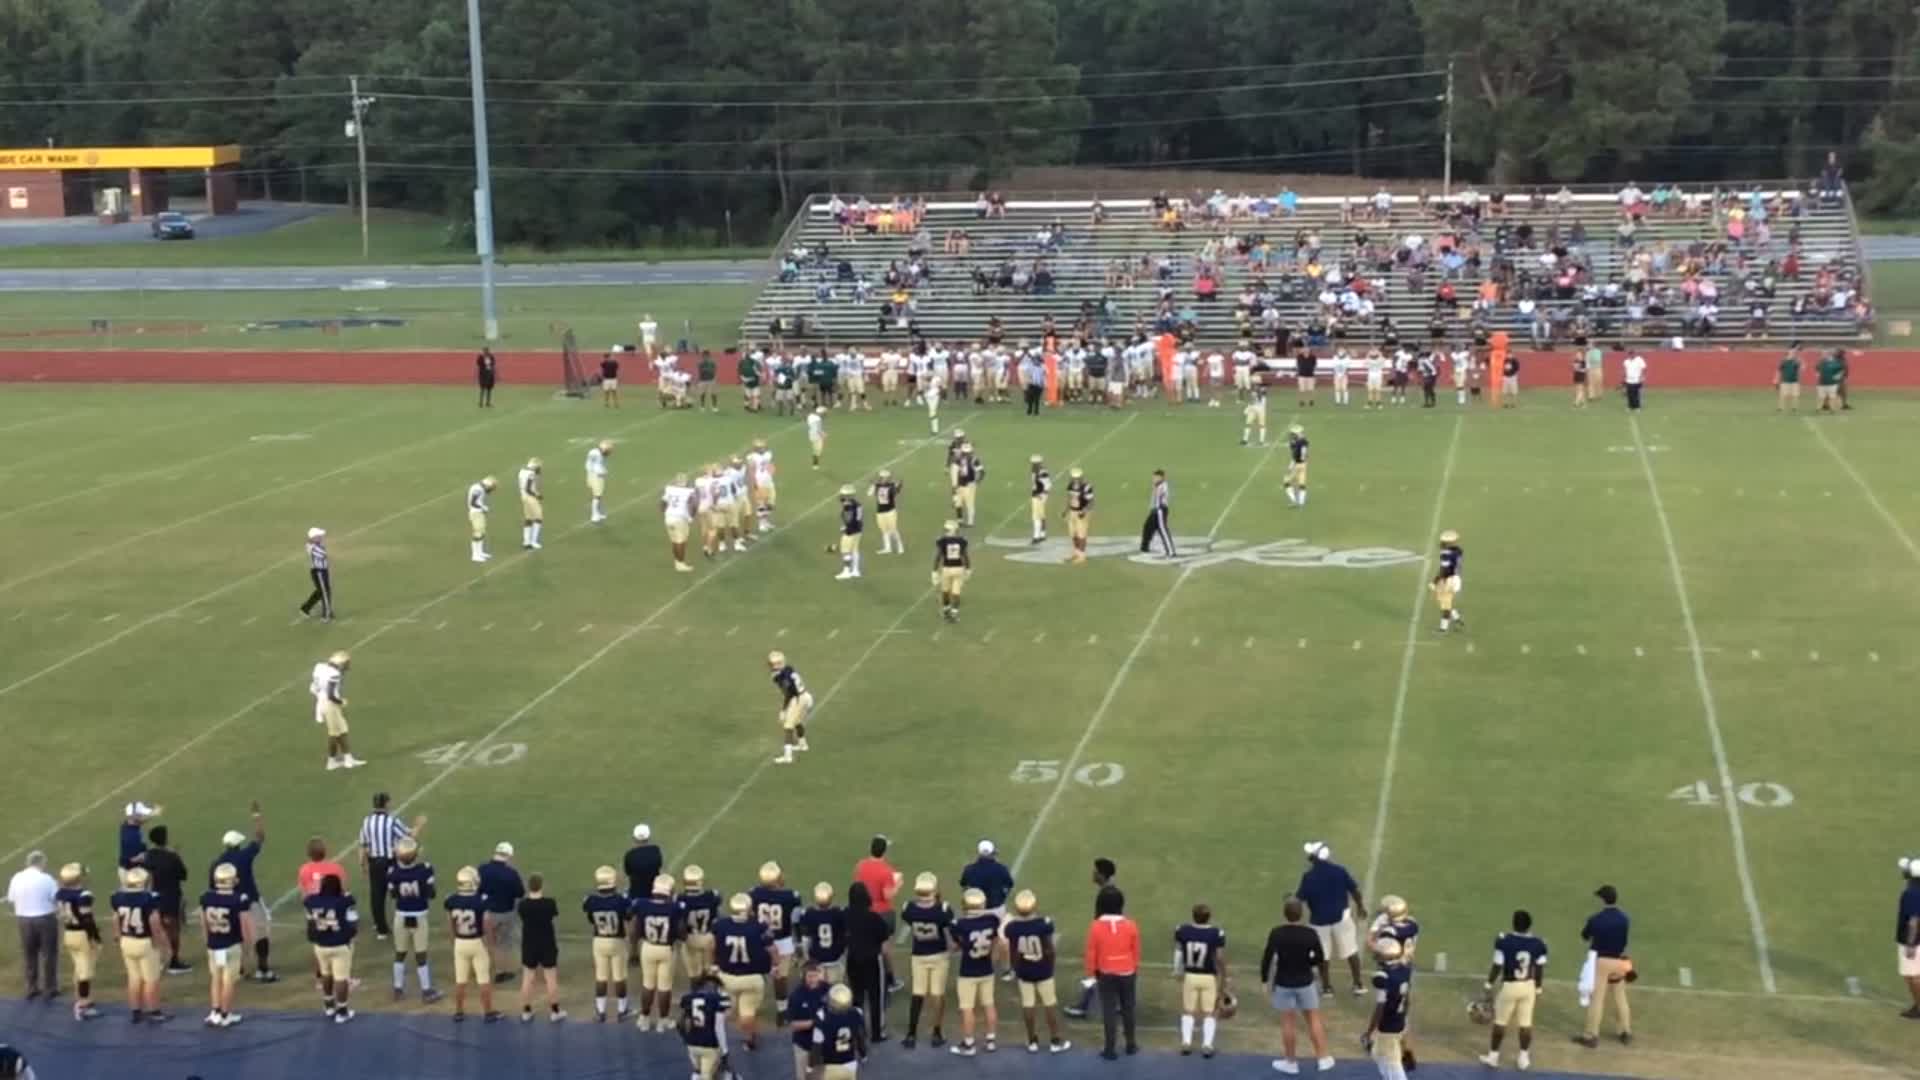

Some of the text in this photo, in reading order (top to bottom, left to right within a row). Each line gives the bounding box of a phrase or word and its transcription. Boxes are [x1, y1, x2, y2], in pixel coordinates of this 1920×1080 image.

[19, 155, 43, 165] CAR
[48, 154, 78, 164] WASH
[415, 740, 529, 767] 40
[1009, 760, 1124, 786] 50
[1667, 780, 1794, 807] 40
[117, 906, 143, 934] 74
[643, 915, 669, 943] 67
[818, 923, 832, 948] 9
[967, 928, 994, 958] 35
[1015, 935, 1041, 962] 40
[725, 935, 750, 964] 71
[1186, 942, 1207, 968] 17
[1513, 951, 1531, 980] 3
[691, 998, 706, 1027] 5
[834, 1027, 851, 1052] 2
